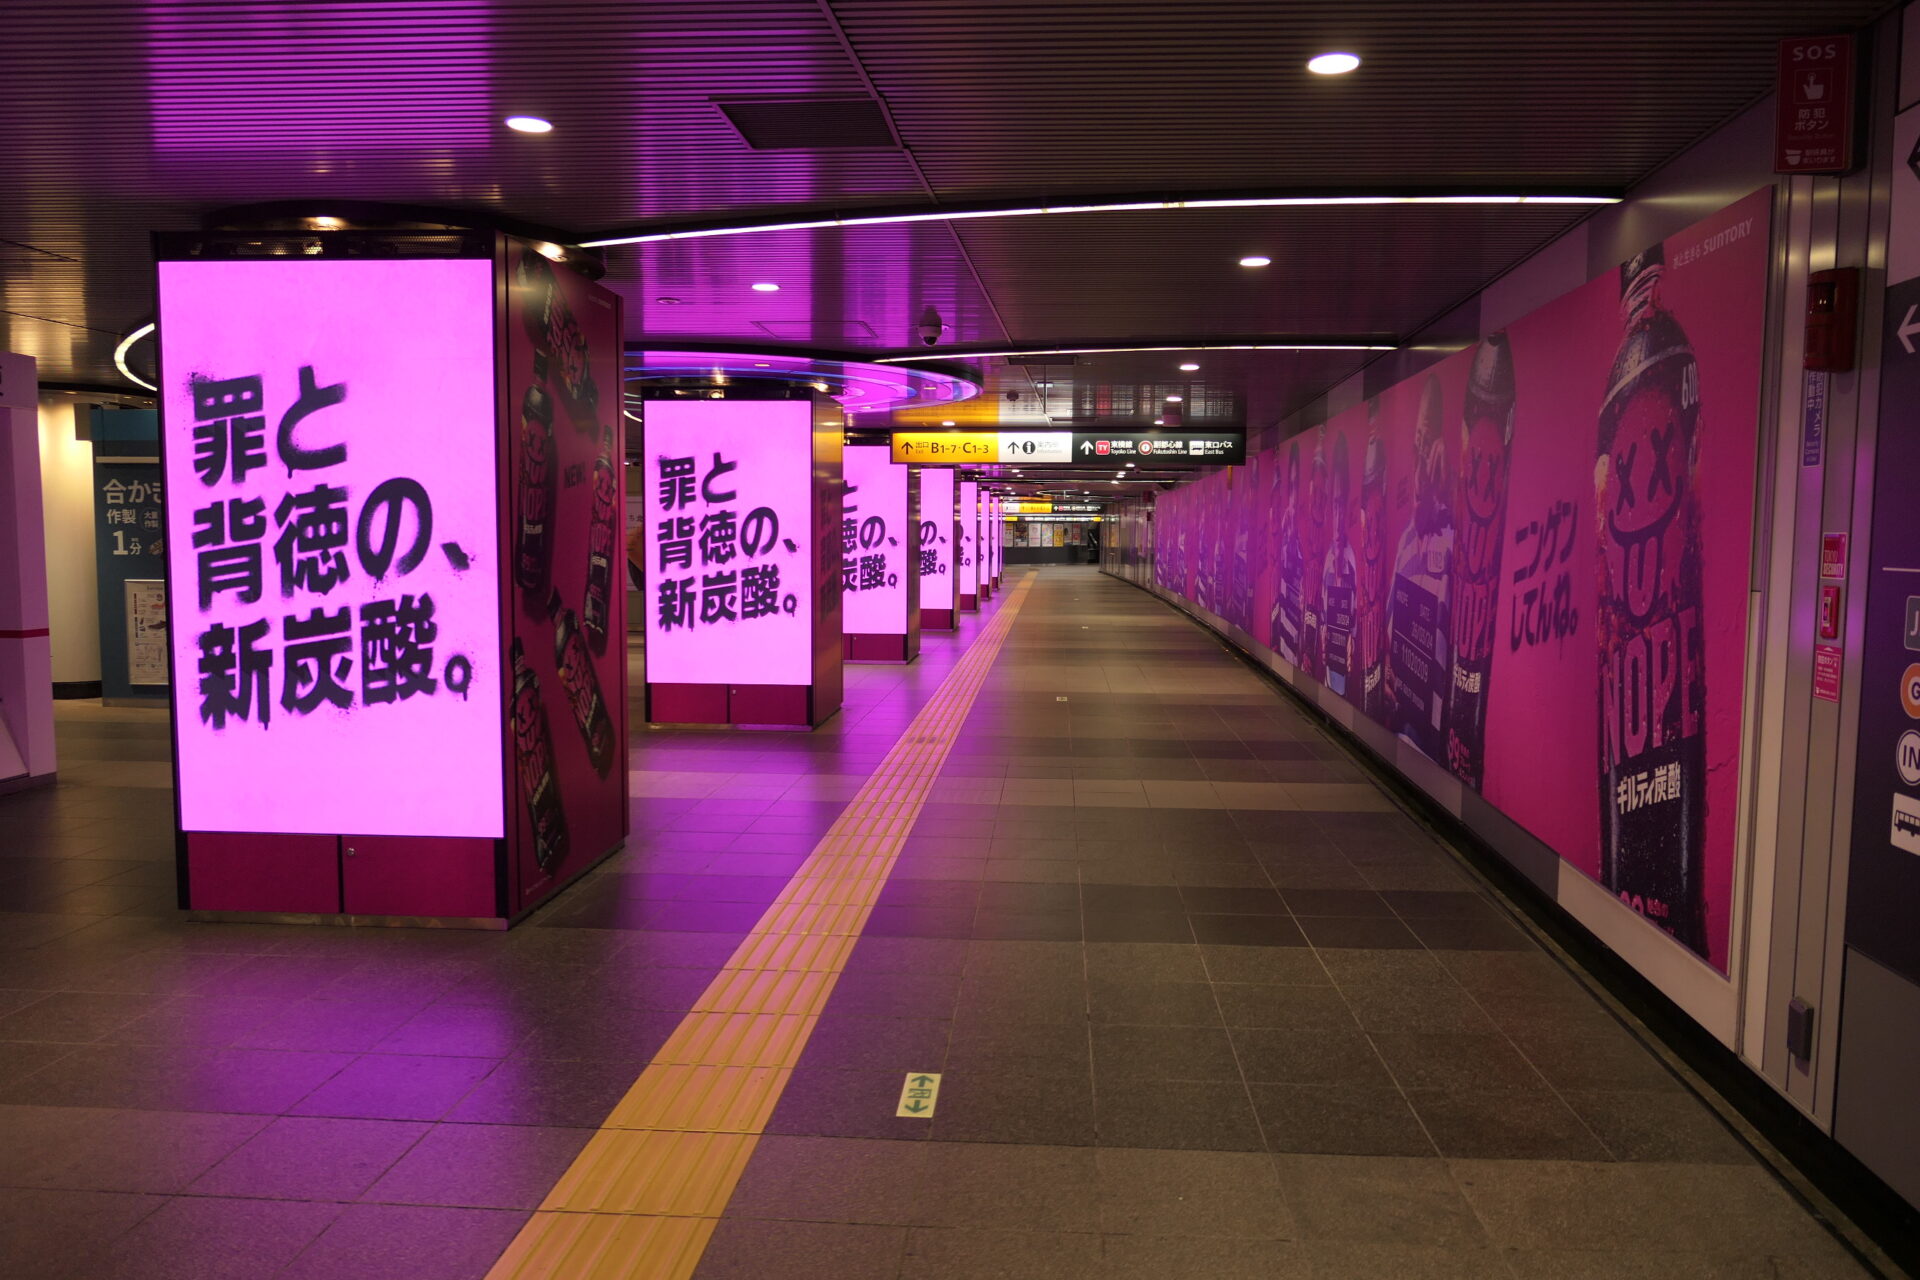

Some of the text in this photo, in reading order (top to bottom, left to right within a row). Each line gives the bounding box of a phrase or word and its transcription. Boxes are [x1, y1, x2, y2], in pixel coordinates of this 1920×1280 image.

[1792, 43, 1836, 61] SOS
[1794, 119, 1829, 131] ボタン
[1798, 107, 1826, 119] 防犯
[192, 365, 347, 486] 罪と
[1205, 440, 1233, 449] 東口バス
[659, 452, 737, 510] 罪と
[106, 508, 137, 525] 作製
[191, 476, 475, 612] 背徳の、
[657, 506, 799, 572] 背徳の、
[1514, 500, 1578, 586] ニンゲン
[658, 563, 798, 632] 新炭酸。
[1511, 572, 1579, 653] してんね。
[197, 593, 473, 732] 新炭酸。
[1616, 762, 1681, 815] ギルティ炭酸
